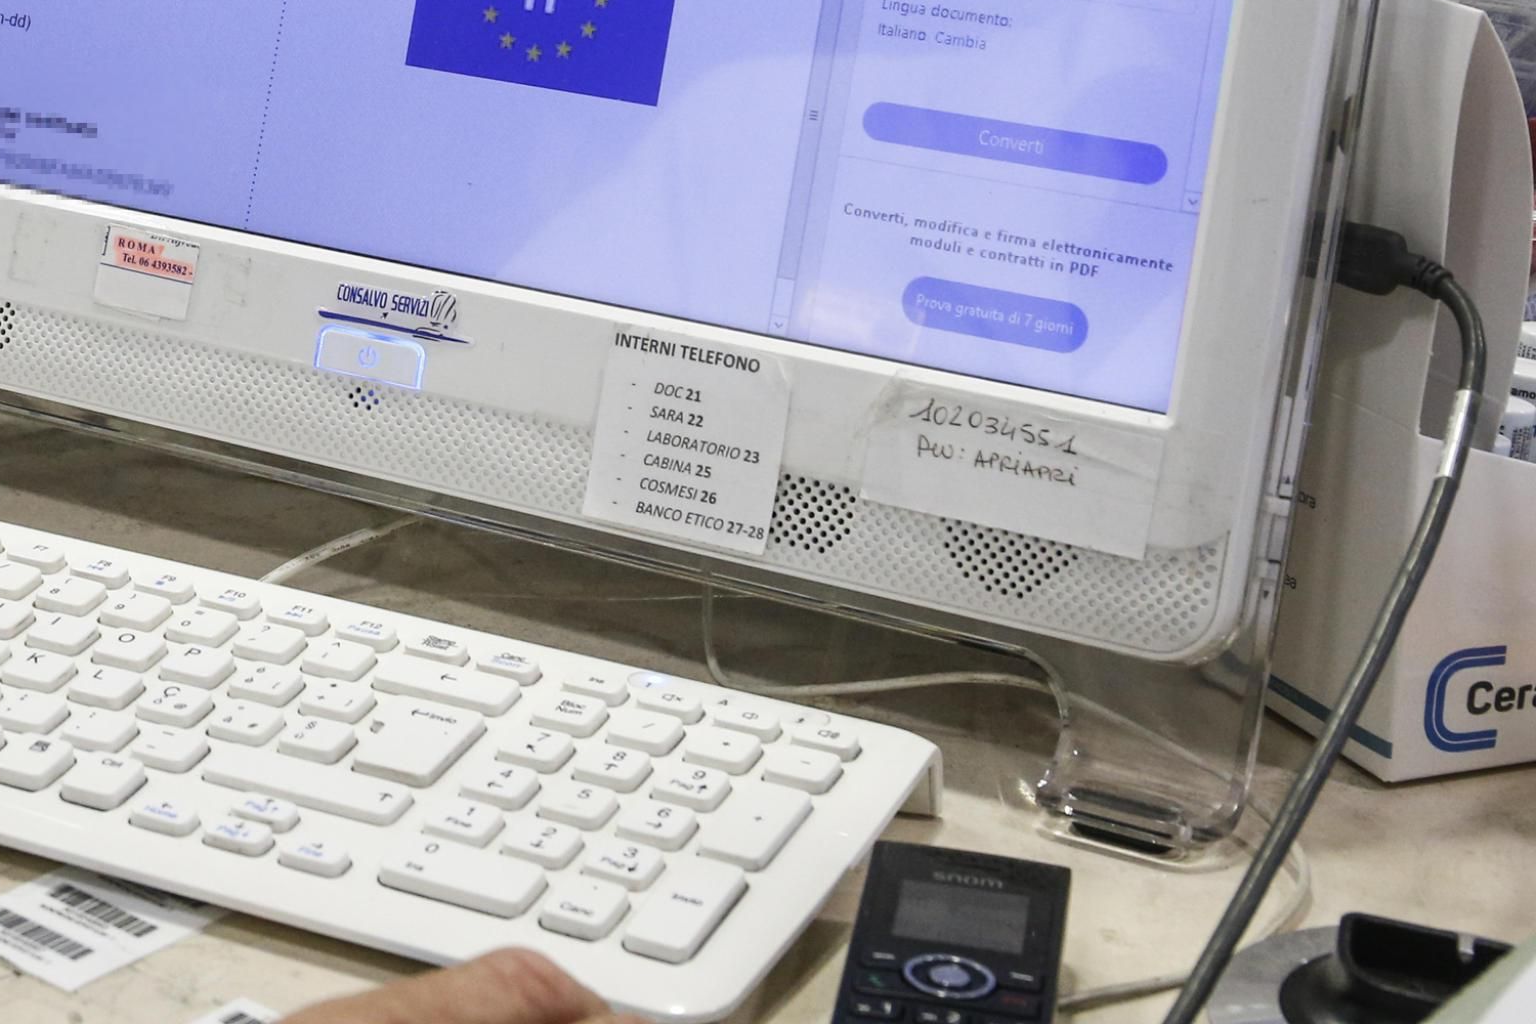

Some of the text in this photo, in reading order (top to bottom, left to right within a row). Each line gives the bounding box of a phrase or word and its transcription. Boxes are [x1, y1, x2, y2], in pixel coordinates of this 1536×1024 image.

[931, 3, 1014, 29] documento:
[877, 23, 987, 51] Italiano Cambia
[977, 129, 1046, 156] Converti
[117, 237, 156, 255] ROMA
[843, 202, 910, 227] Converti,
[914, 215, 980, 239] modifica
[996, 229, 1037, 249] firma
[1041, 235, 1175, 274] elettronicamente
[909, 233, 963, 255] moduli
[979, 246, 1046, 271] contratti
[1049, 258, 1065, 273] in
[1068, 260, 1101, 279] PDF
[337, 283, 430, 318] CONSALVO SERVIZI
[916, 293, 1075, 337] Prova gratuita di 7 giorni
[614, 332, 761, 374] INTERNI TELEFONO
[653, 381, 702, 403] DOC 21
[649, 405, 704, 429] SARA 22
[646, 429, 761, 465] LABORATORIO 23
[643, 453, 712, 479] CABINA 25
[639, 476, 718, 506] COSMESI 26
[635, 500, 765, 542] BANCO ETICO 27-28
[1466, 680, 1536, 716] Cer
